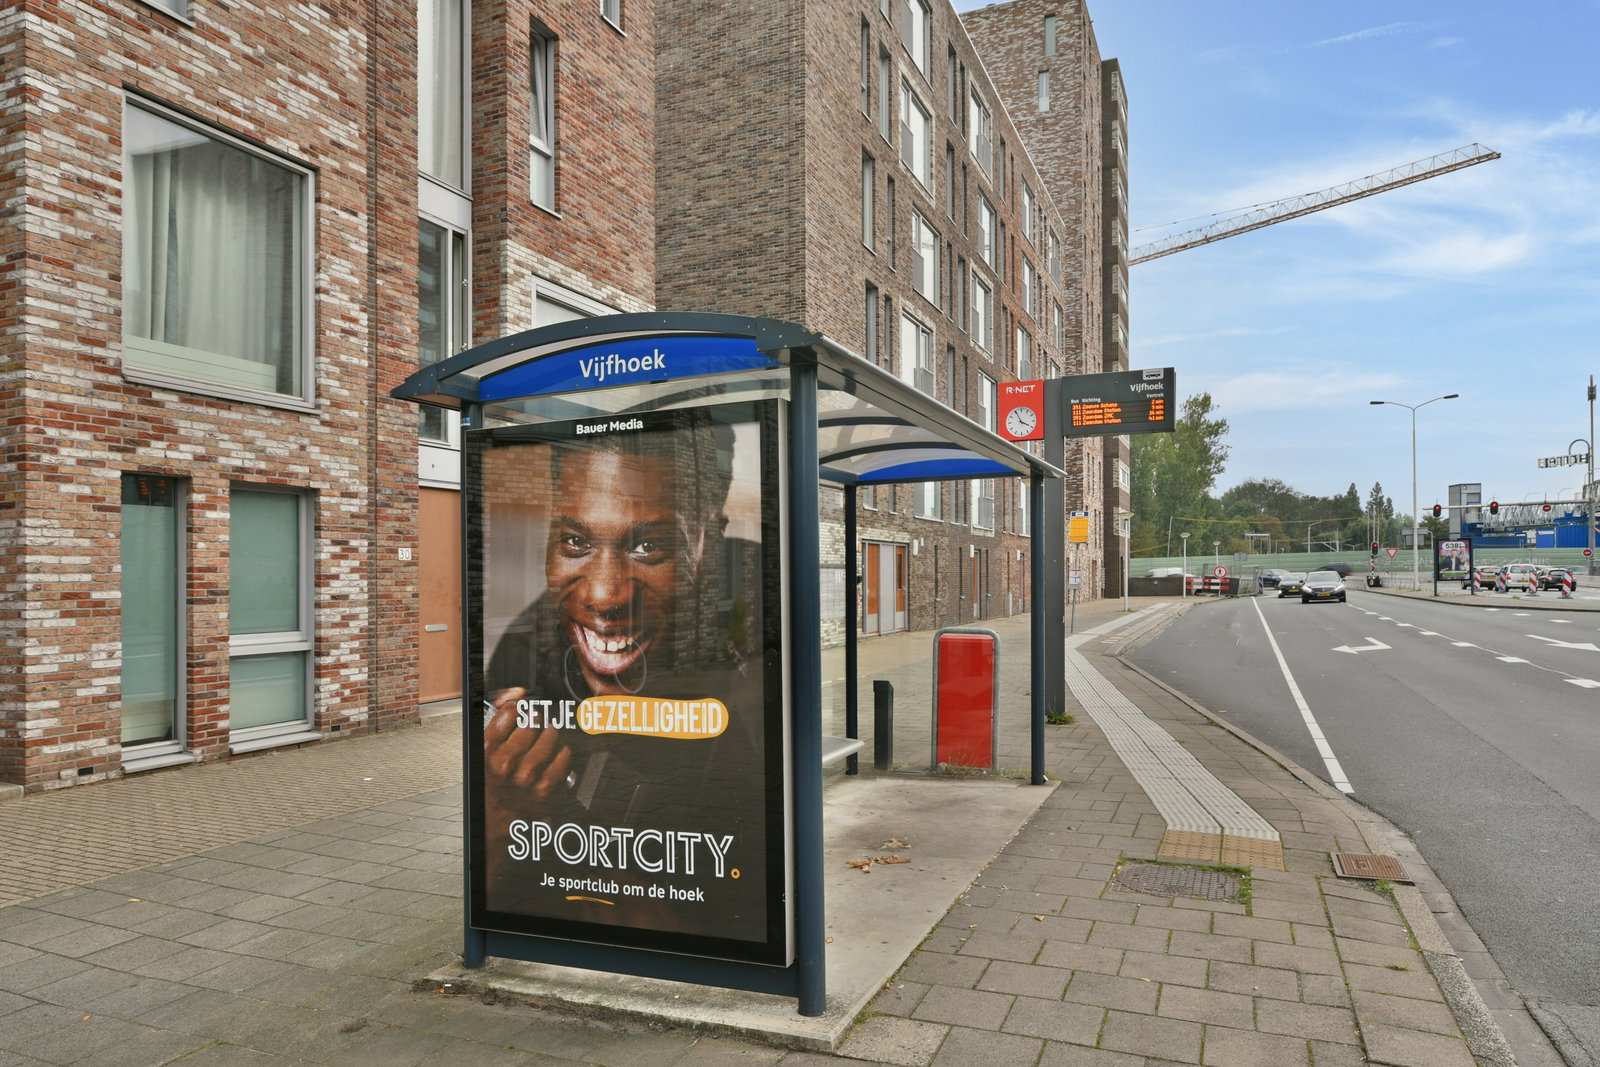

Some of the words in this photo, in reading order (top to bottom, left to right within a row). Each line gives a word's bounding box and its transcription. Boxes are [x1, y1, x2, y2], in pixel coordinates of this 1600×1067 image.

[579, 348, 666, 382] Vijfhoek
[1130, 381, 1164, 393] Vijfhoek
[576, 423, 608, 435] Bauer
[609, 418, 644, 432] Media
[399, 549, 410, 560] 30
[580, 701, 721, 734] GEZELLIGHEID
[507, 819, 741, 879] SPORTCITY.
[540, 872, 555, 887] Je
[558, 875, 619, 895] sportclub
[622, 884, 644, 897] om
[648, 883, 665, 899] de
[669, 885, 705, 902] hoek
